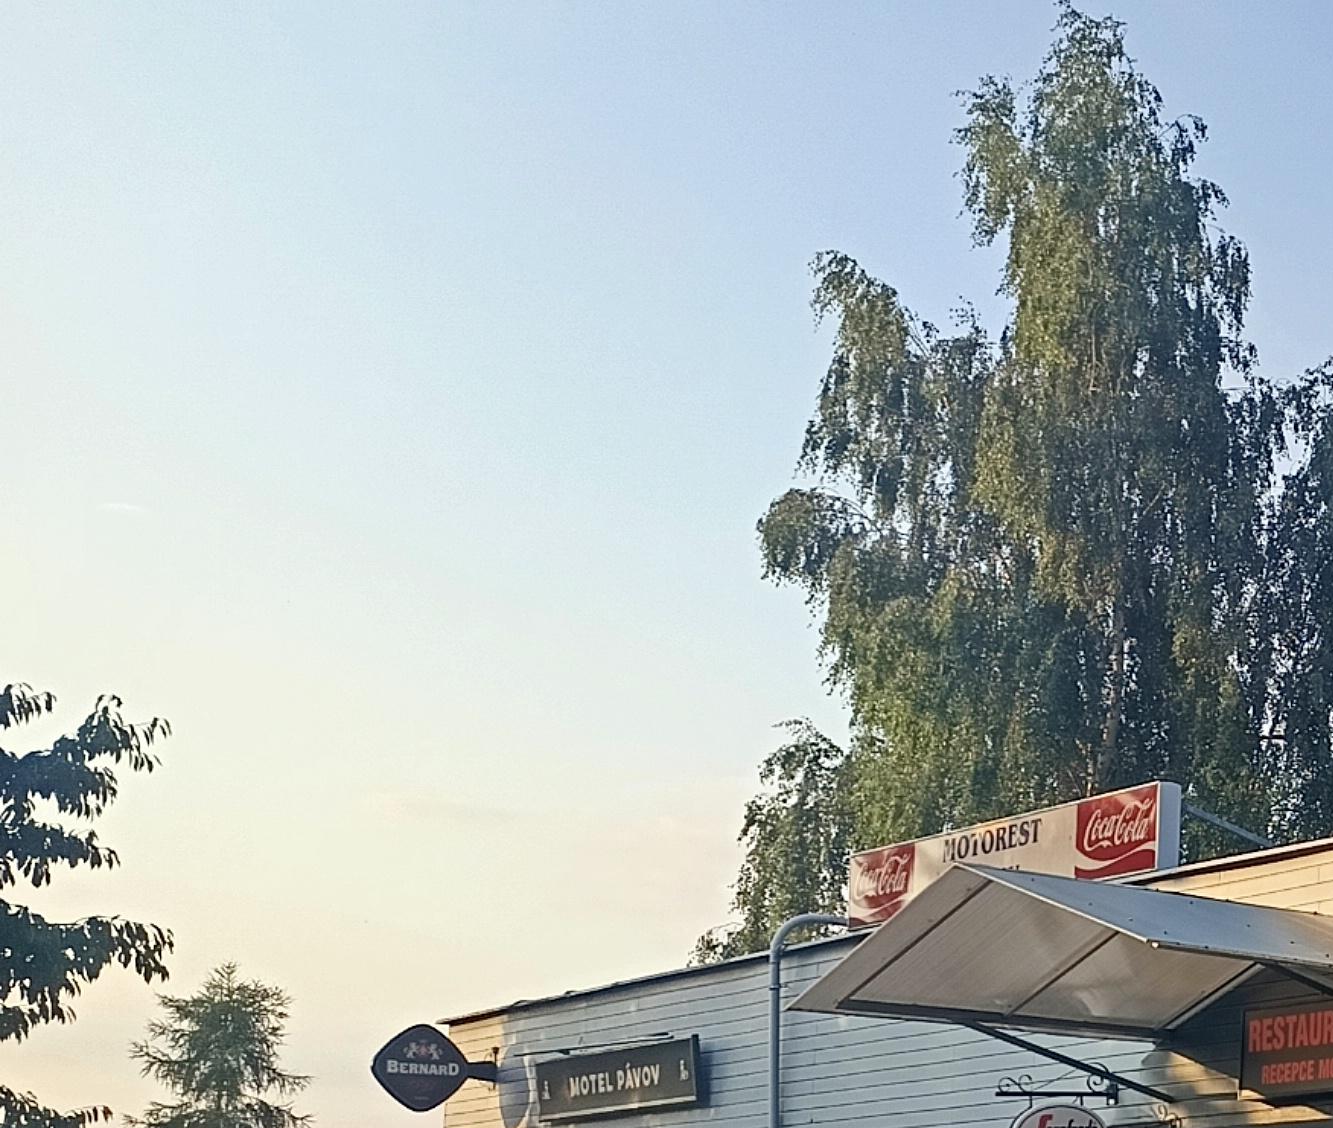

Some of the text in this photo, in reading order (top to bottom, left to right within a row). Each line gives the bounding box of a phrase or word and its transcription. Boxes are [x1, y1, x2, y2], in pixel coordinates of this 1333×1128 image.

[942, 818, 1042, 863] MOTOREST
[1084, 797, 1152, 851] Coca-Cola
[855, 853, 909, 900] Coca-Cola
[386, 1060, 459, 1076] BERNARD
[569, 1062, 660, 1098] MOTEL PÁVOV
[1262, 1060, 1315, 1085] RECEPCE
